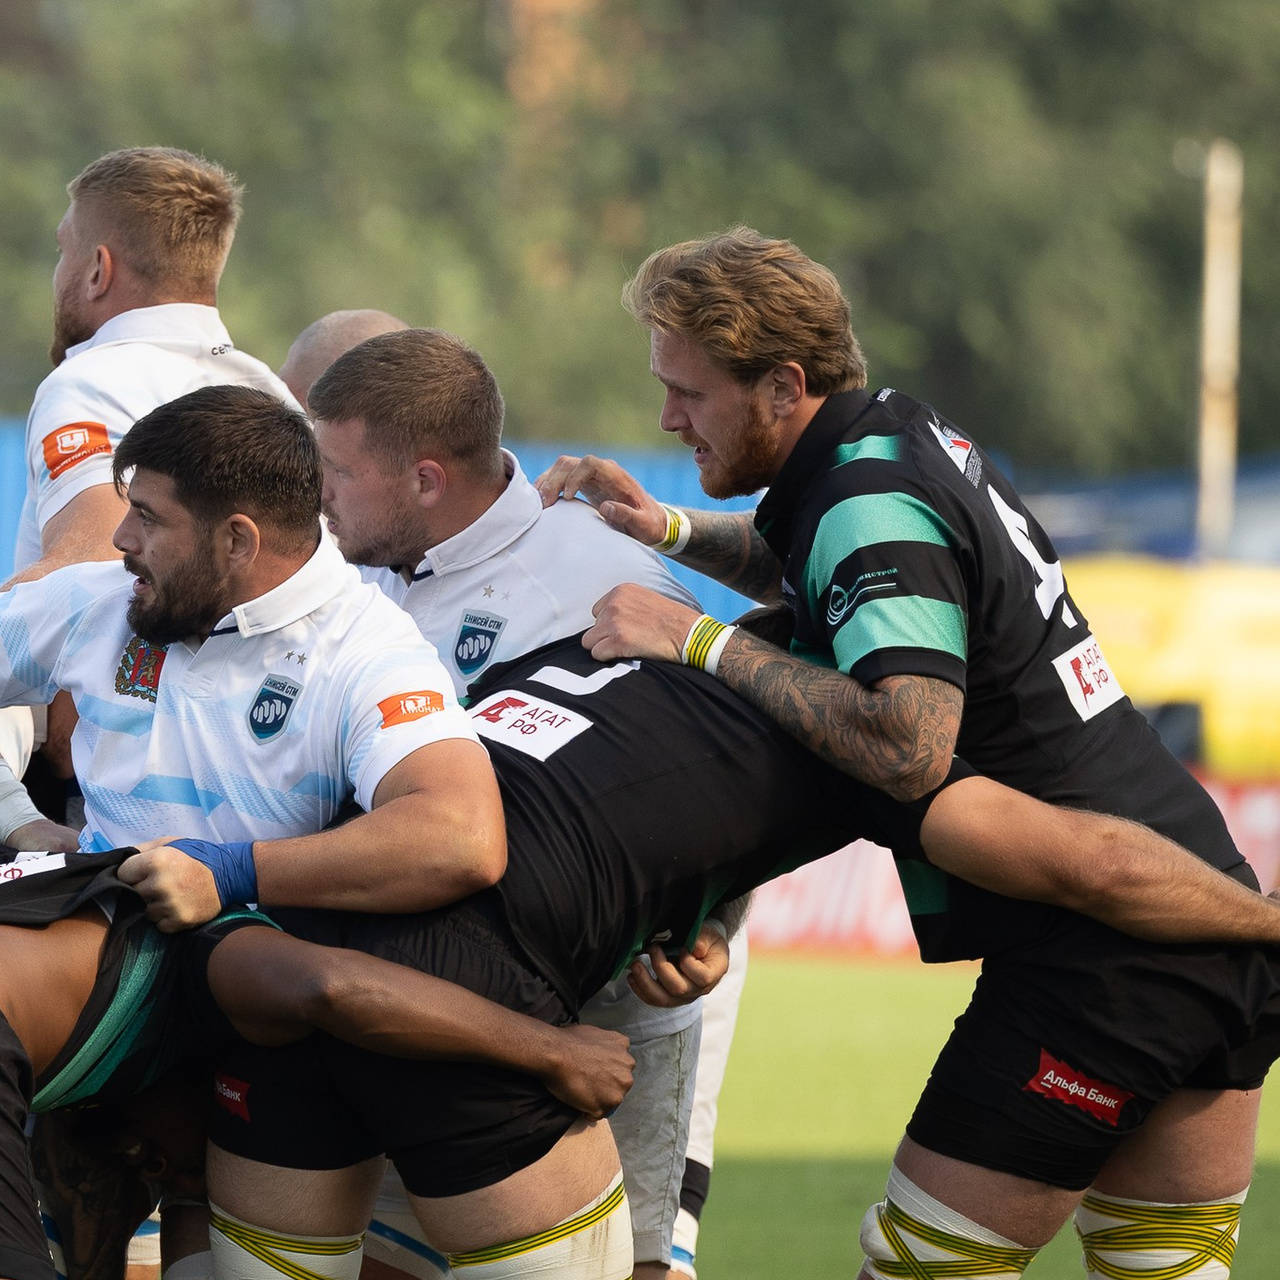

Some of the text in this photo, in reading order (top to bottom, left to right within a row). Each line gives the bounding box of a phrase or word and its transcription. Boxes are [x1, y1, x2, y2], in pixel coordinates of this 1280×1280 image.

[464, 613, 503, 630] ЕНИСЕЙ СТМ
[264, 677, 299, 697] ЕНИСЕЙ СТМ
[1093, 668, 1109, 689] РФ
[507, 718, 538, 735] РФ
[522, 707, 572, 729] АГАТ
[222, 1083, 241, 1102] Банк
[1041, 1070, 1119, 1109] Альфа Банк
